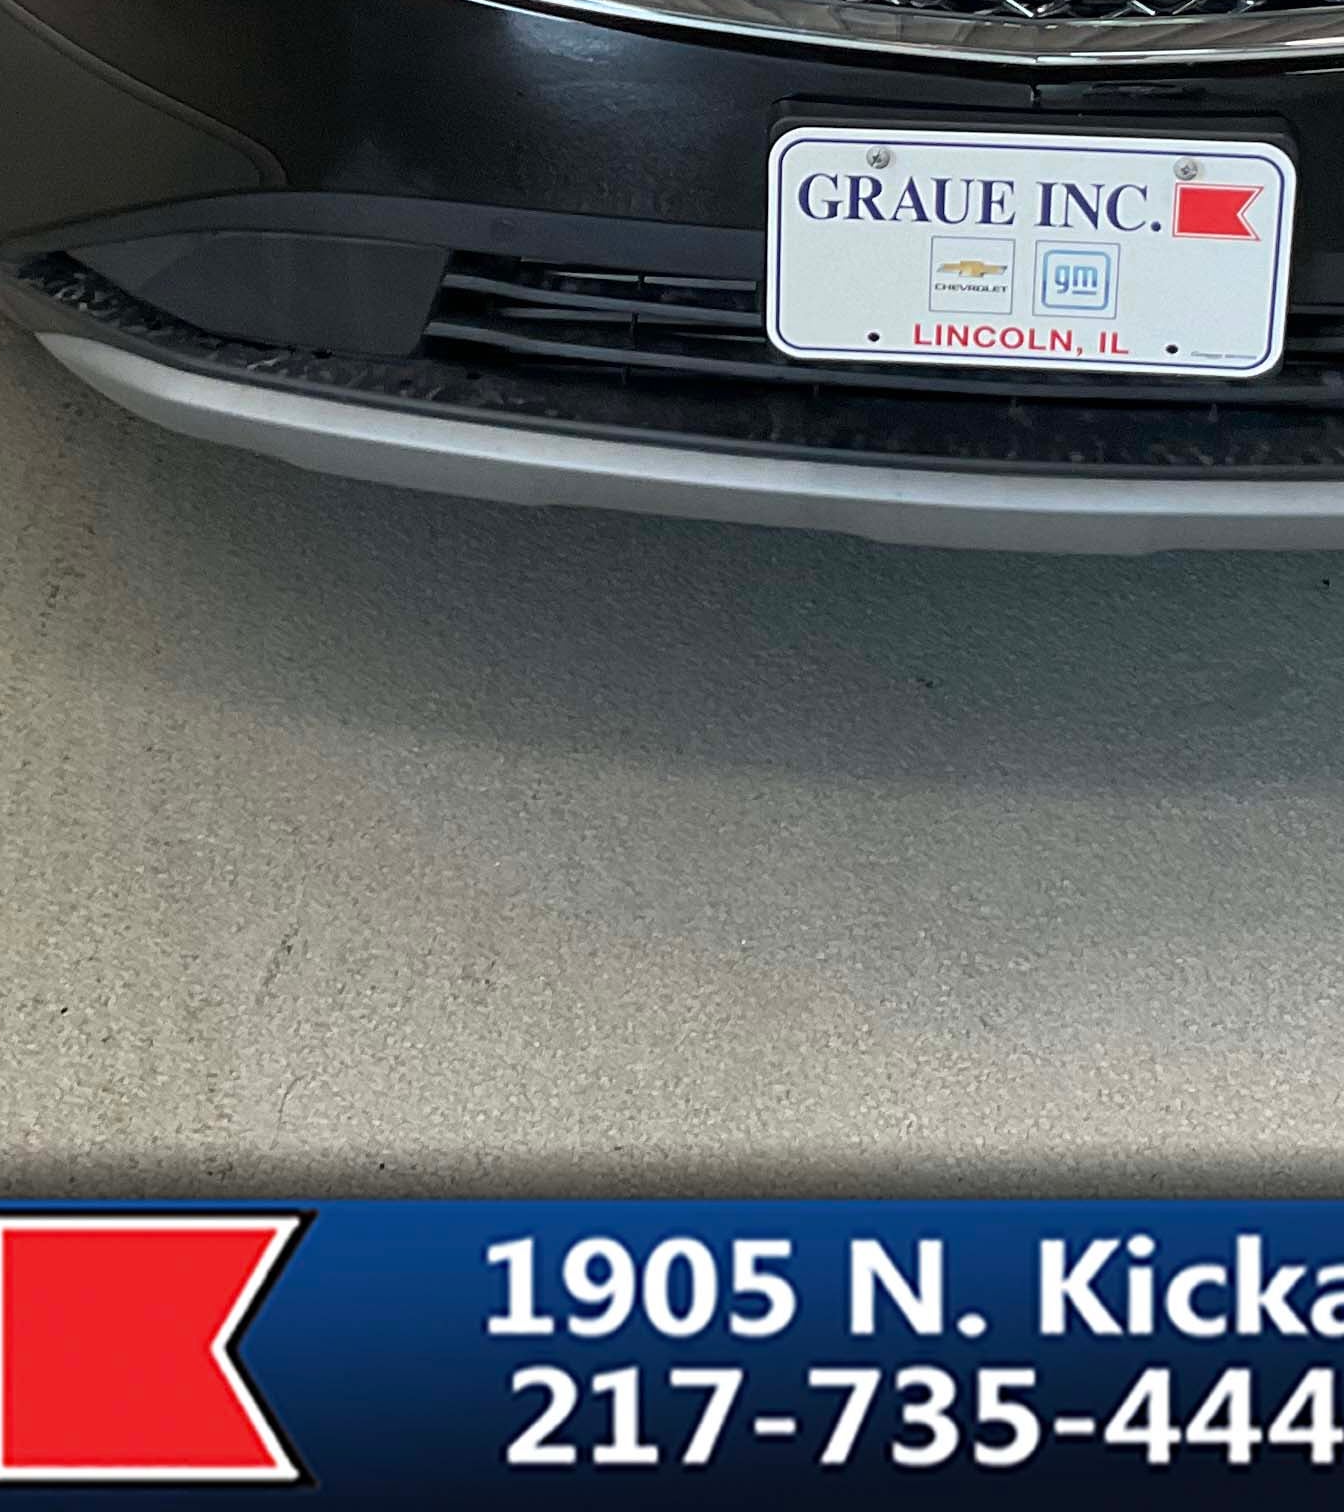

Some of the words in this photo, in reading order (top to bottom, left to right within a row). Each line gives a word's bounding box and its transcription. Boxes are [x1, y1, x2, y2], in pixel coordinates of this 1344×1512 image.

[797, 173, 1017, 226] GRAUE
[1034, 181, 1162, 232] INC.
[934, 281, 1008, 294] CHEVROLET
[1055, 264, 1099, 295] gm
[912, 323, 1084, 358] LINCOLN,
[1099, 331, 1130, 356] IL
